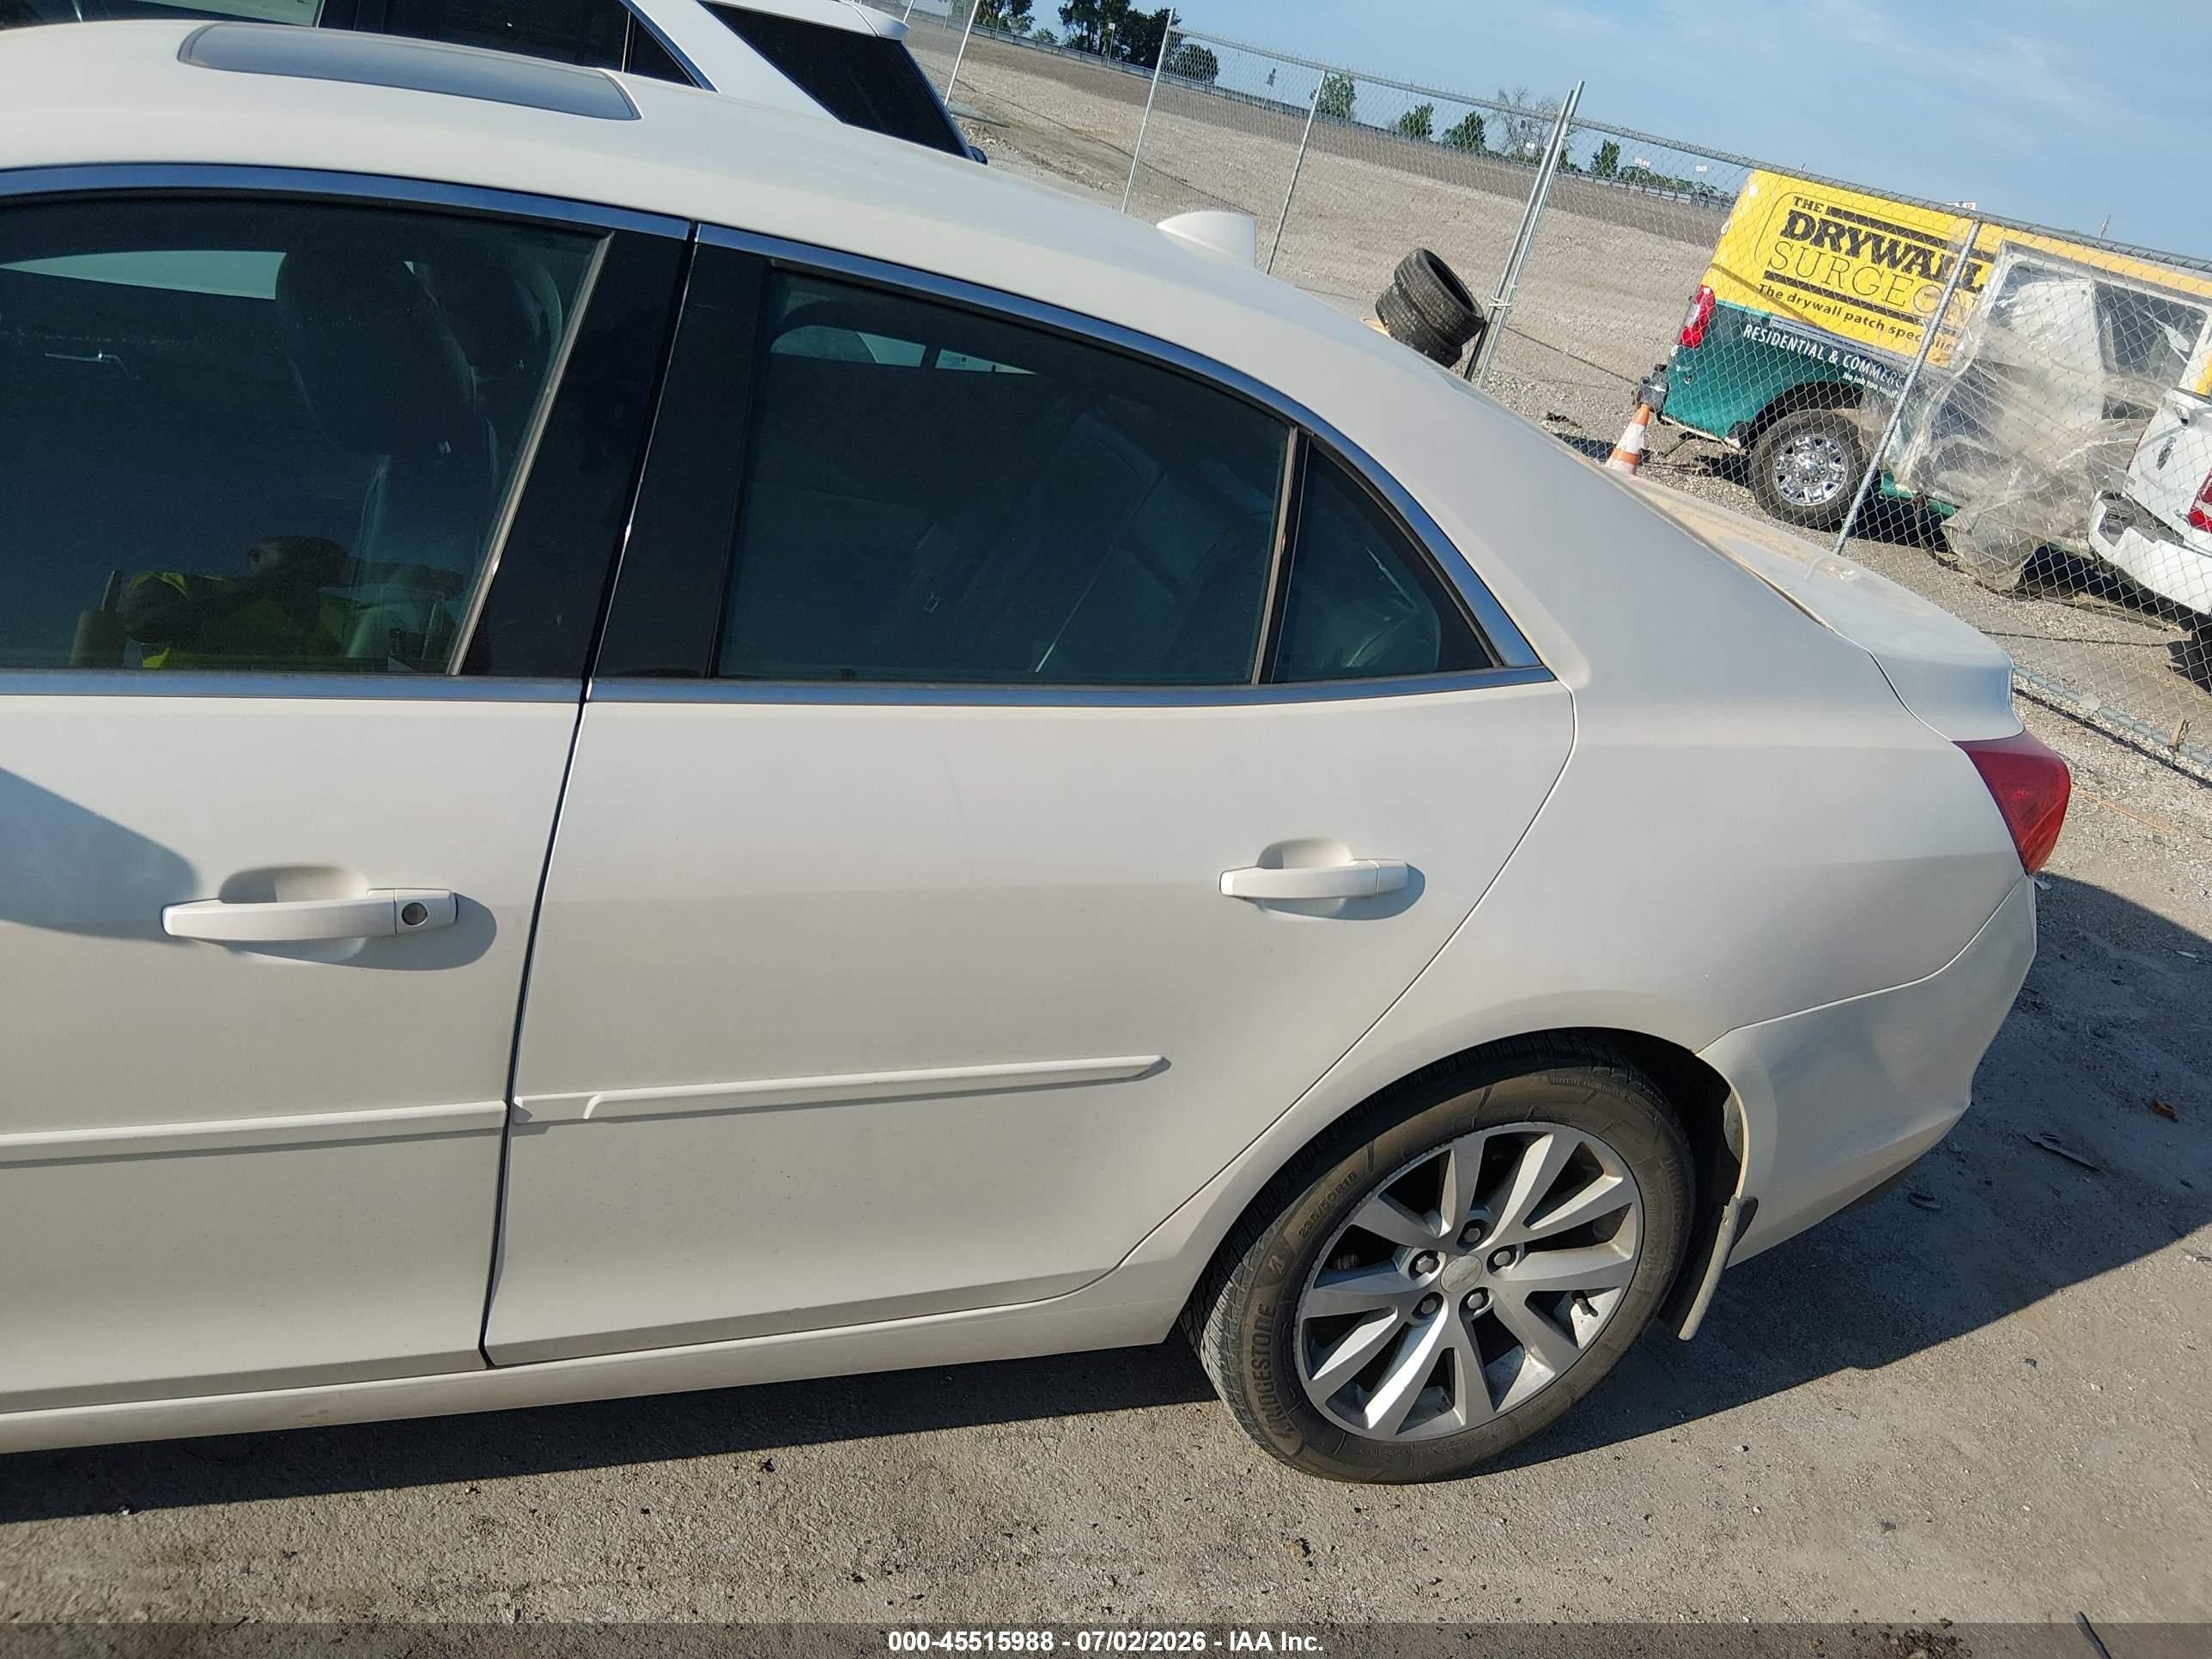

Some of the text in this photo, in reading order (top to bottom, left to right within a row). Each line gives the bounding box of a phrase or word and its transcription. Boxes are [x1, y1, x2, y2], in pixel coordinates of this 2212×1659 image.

[1793, 197, 1824, 213] THE
[1767, 241, 1978, 321] SURGEON
[1780, 209, 1984, 294] DRYWALL
[1759, 283, 1784, 300] The
[1787, 293, 1843, 317] drywall
[1843, 313, 1885, 331] patch
[1742, 324, 1824, 360] RESIDENTIAL
[1828, 349, 1838, 364] &
[1297, 1170, 1358, 1238] 235/50R18
[1250, 1303, 1295, 1439] BRIDGESTONE
